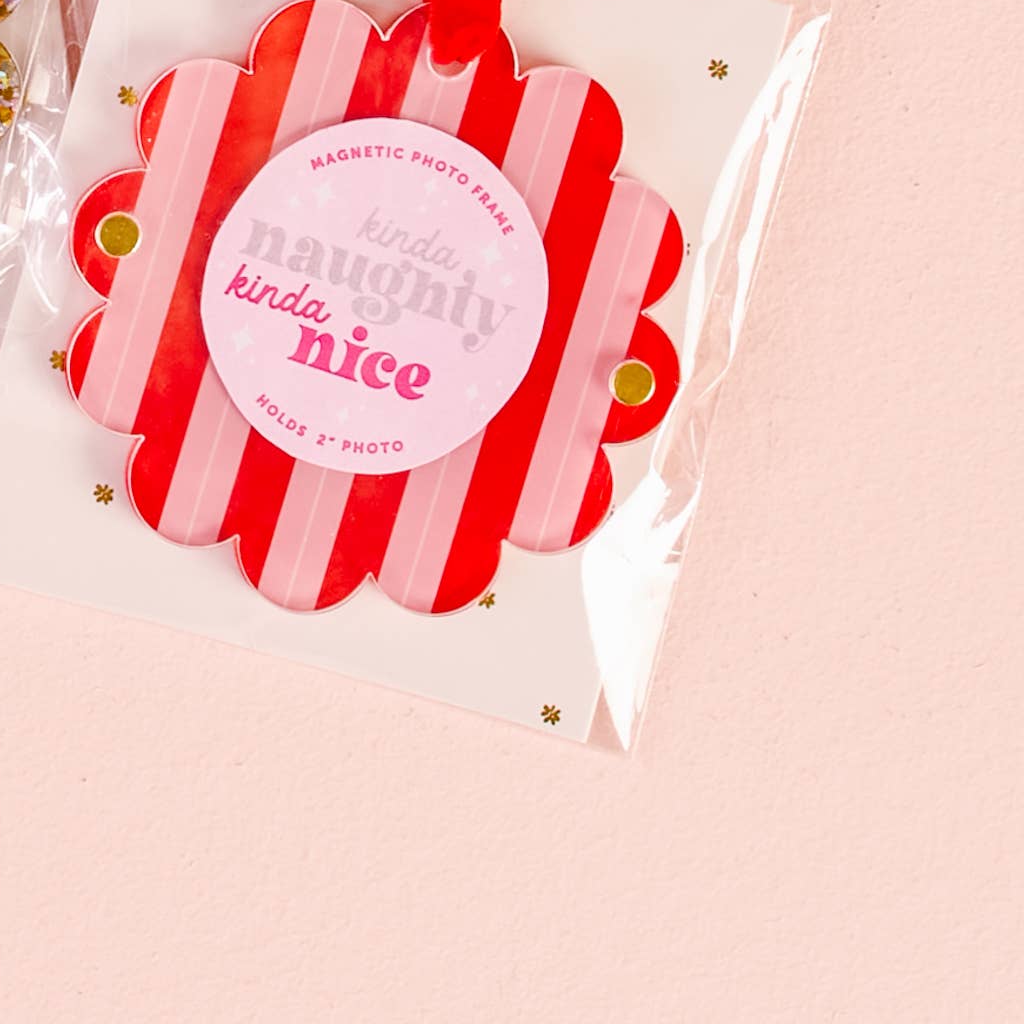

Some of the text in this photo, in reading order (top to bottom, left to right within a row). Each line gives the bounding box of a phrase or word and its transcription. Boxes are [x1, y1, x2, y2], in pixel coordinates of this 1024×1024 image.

[309, 144, 516, 237] MAGNETIC PHOTO FRAME
[356, 206, 461, 272] kinda
[224, 263, 333, 324] kinda
[238, 216, 518, 354] naughty
[286, 323, 432, 401] nice
[255, 392, 308, 438] HOLDS
[341, 439, 404, 455] PHOTO
